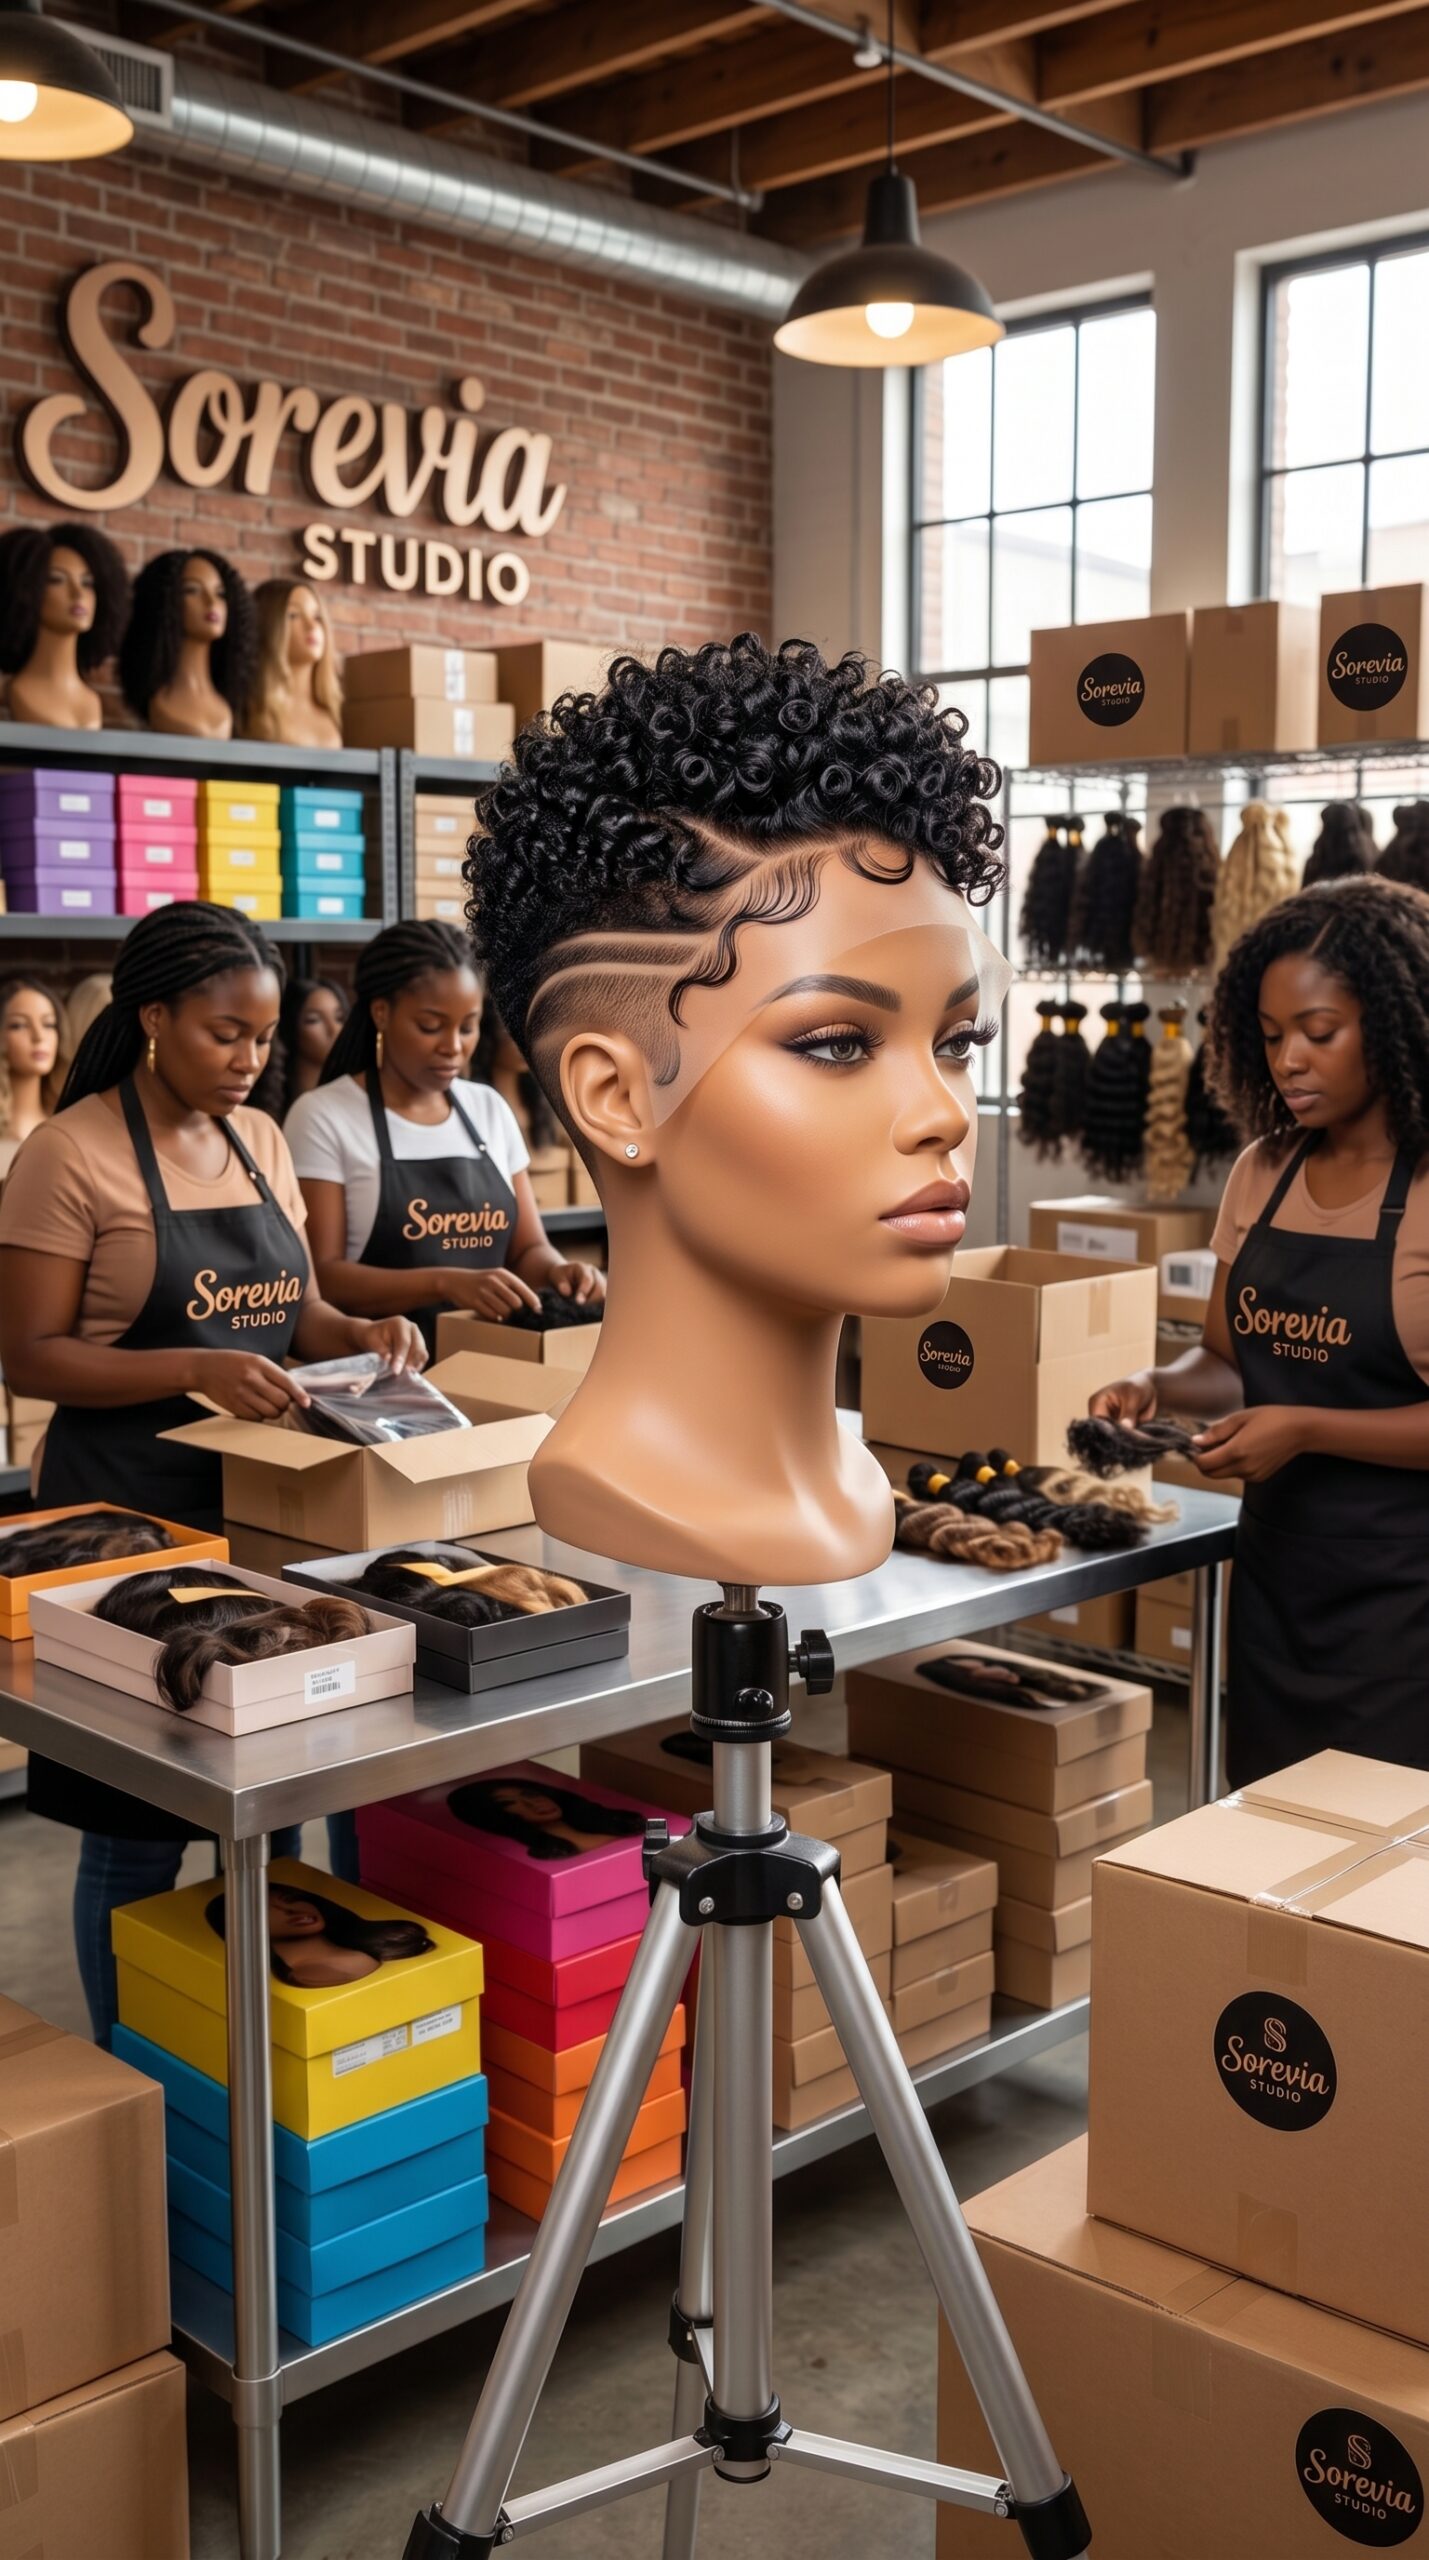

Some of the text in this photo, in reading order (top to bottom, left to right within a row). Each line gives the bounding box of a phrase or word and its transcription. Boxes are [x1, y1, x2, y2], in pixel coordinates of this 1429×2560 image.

[21, 261, 567, 538] Sorevia
[302, 523, 531, 606] STUDIO
[1330, 651, 1405, 679] Sorevia
[1080, 676, 1143, 702] Sorevia
[1355, 675, 1389, 685] STUDIO
[402, 1198, 510, 1240] Sorevia
[442, 1235, 493, 1250] STUDIO
[186, 1269, 303, 1320] Sorevia
[231, 1310, 286, 1330] STUDIO
[1234, 1286, 1352, 1345] Sorevia
[919, 1341, 972, 1366] Sorevia
[1272, 1341, 1329, 1363] STUDIO
[1221, 2035, 1330, 2095] Sorevia
[1250, 2078, 1301, 2103] STUDIO
[1303, 2448, 1416, 2514] Sorevia
[1334, 2492, 1387, 2520] STUDIO
